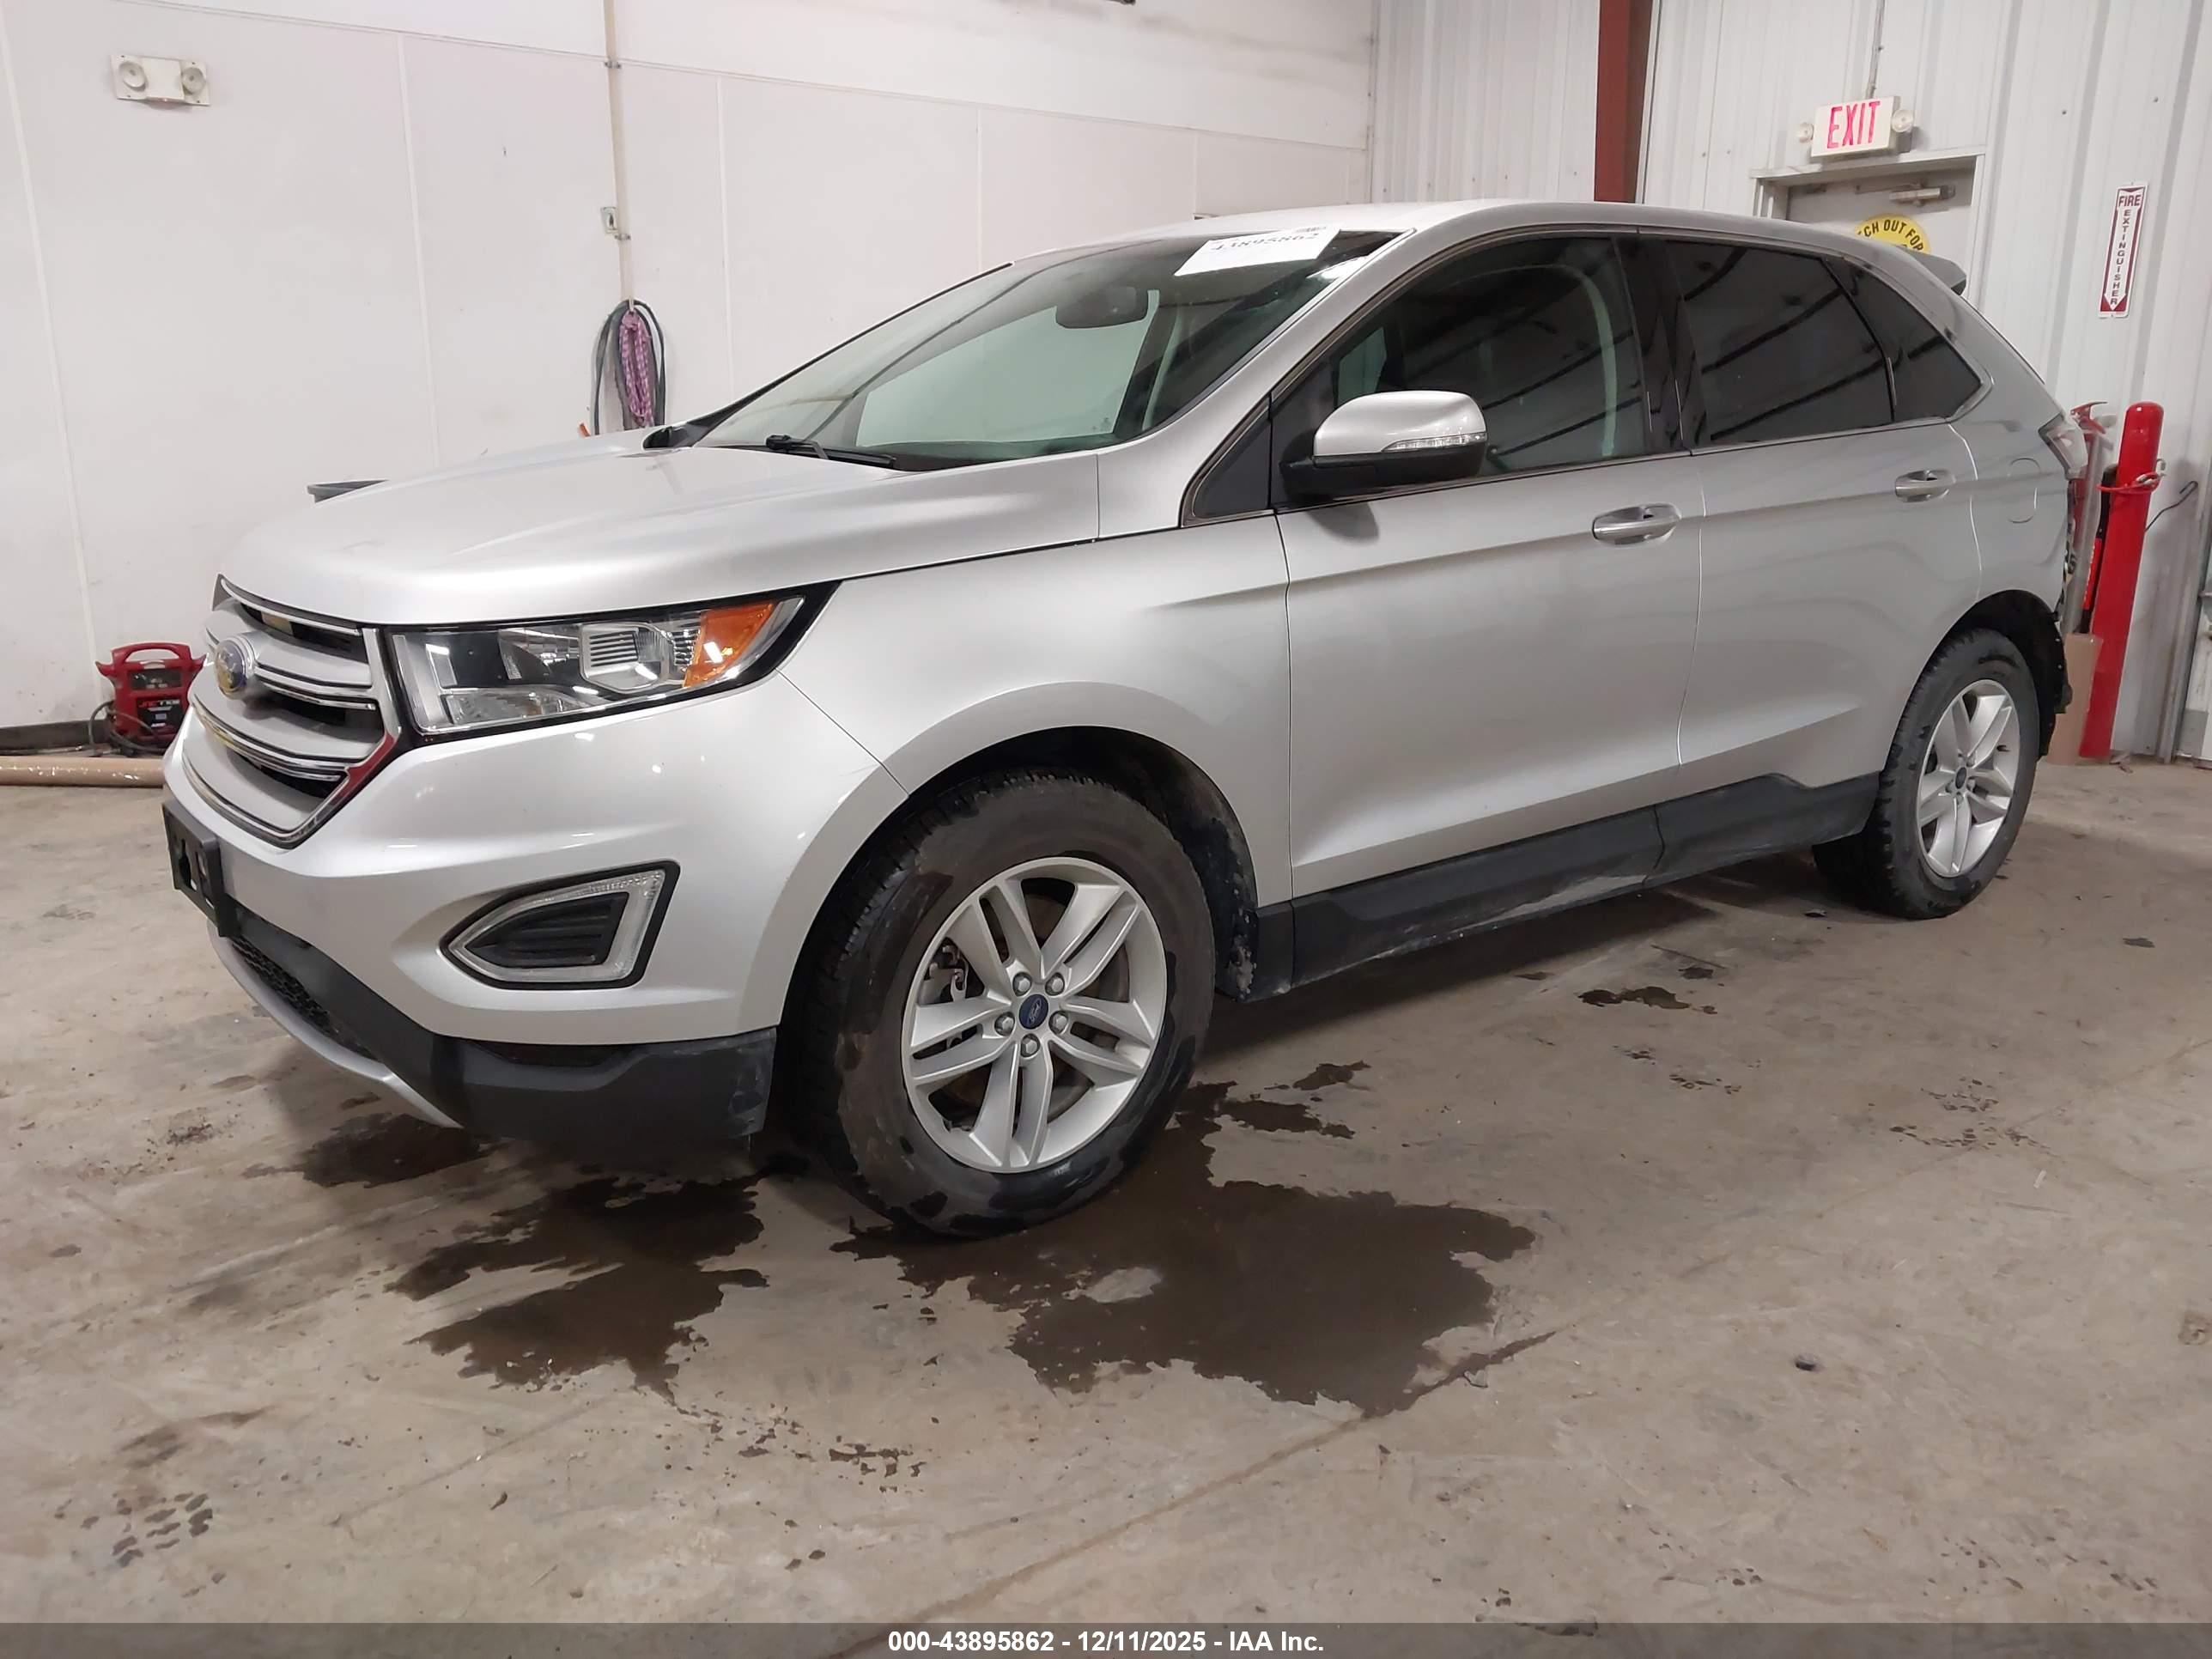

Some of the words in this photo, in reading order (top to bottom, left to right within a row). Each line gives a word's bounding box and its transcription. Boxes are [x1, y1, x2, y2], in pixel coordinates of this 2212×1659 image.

[1826, 100, 1881, 149] EXIT
[2118, 194, 2142, 208] FIRE
[1883, 219, 1907, 234] OUT
[2110, 209, 2131, 305] EXTINGUISHER
